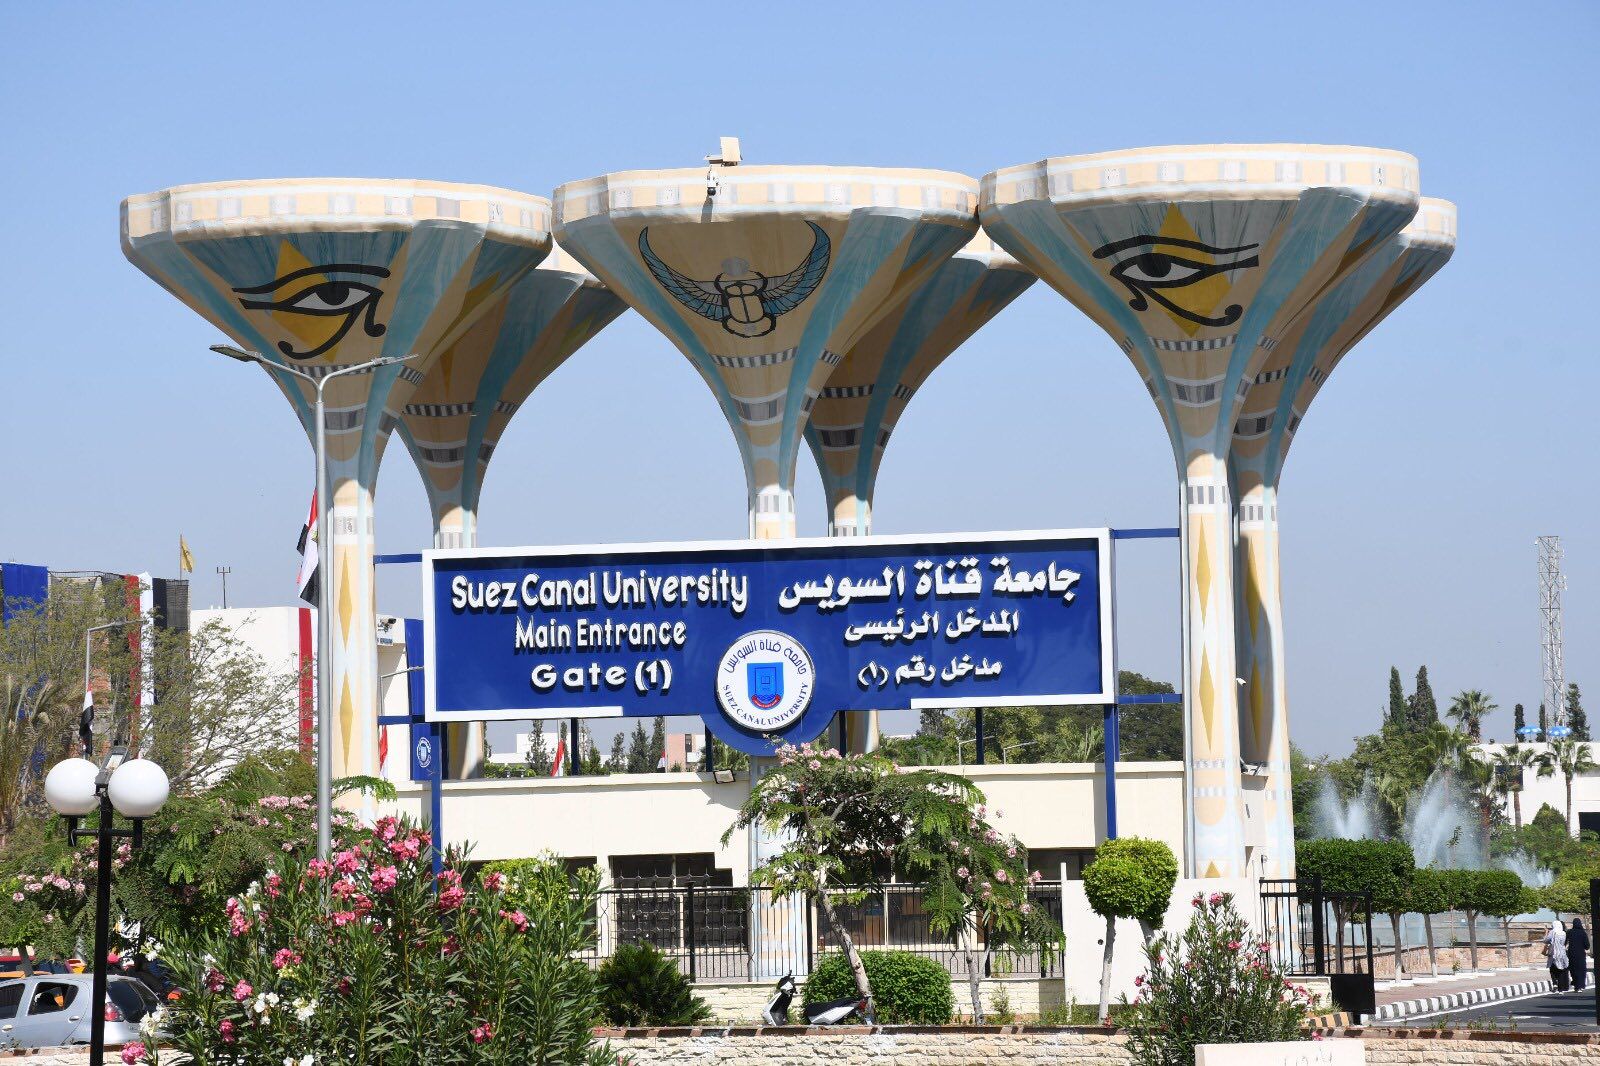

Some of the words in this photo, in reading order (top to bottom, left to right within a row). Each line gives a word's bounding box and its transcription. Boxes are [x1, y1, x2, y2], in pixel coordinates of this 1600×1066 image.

[452, 575, 518, 609] Suez
[521, 572, 597, 607] Canal
[602, 567, 748, 613] University
[778, 565, 906, 610] السويس
[913, 555, 983, 595] قناة
[991, 555, 1081, 602] جامعة
[515, 615, 571, 649] Main
[577, 618, 687, 647] Entrance
[945, 606, 1020, 638] المدخل
[724, 639, 758, 674] السويس
[759, 638, 782, 653] قناة
[783, 646, 807, 675] جامعة
[531, 662, 627, 689] Gate
[634, 659, 673, 691] (1)
[895, 654, 937, 684] رقم
[940, 653, 1003, 681] مدخل
[723, 684, 738, 709] SUEZ
[736, 708, 766, 725] CANAL
[767, 682, 809, 725] UNIVERSITY
